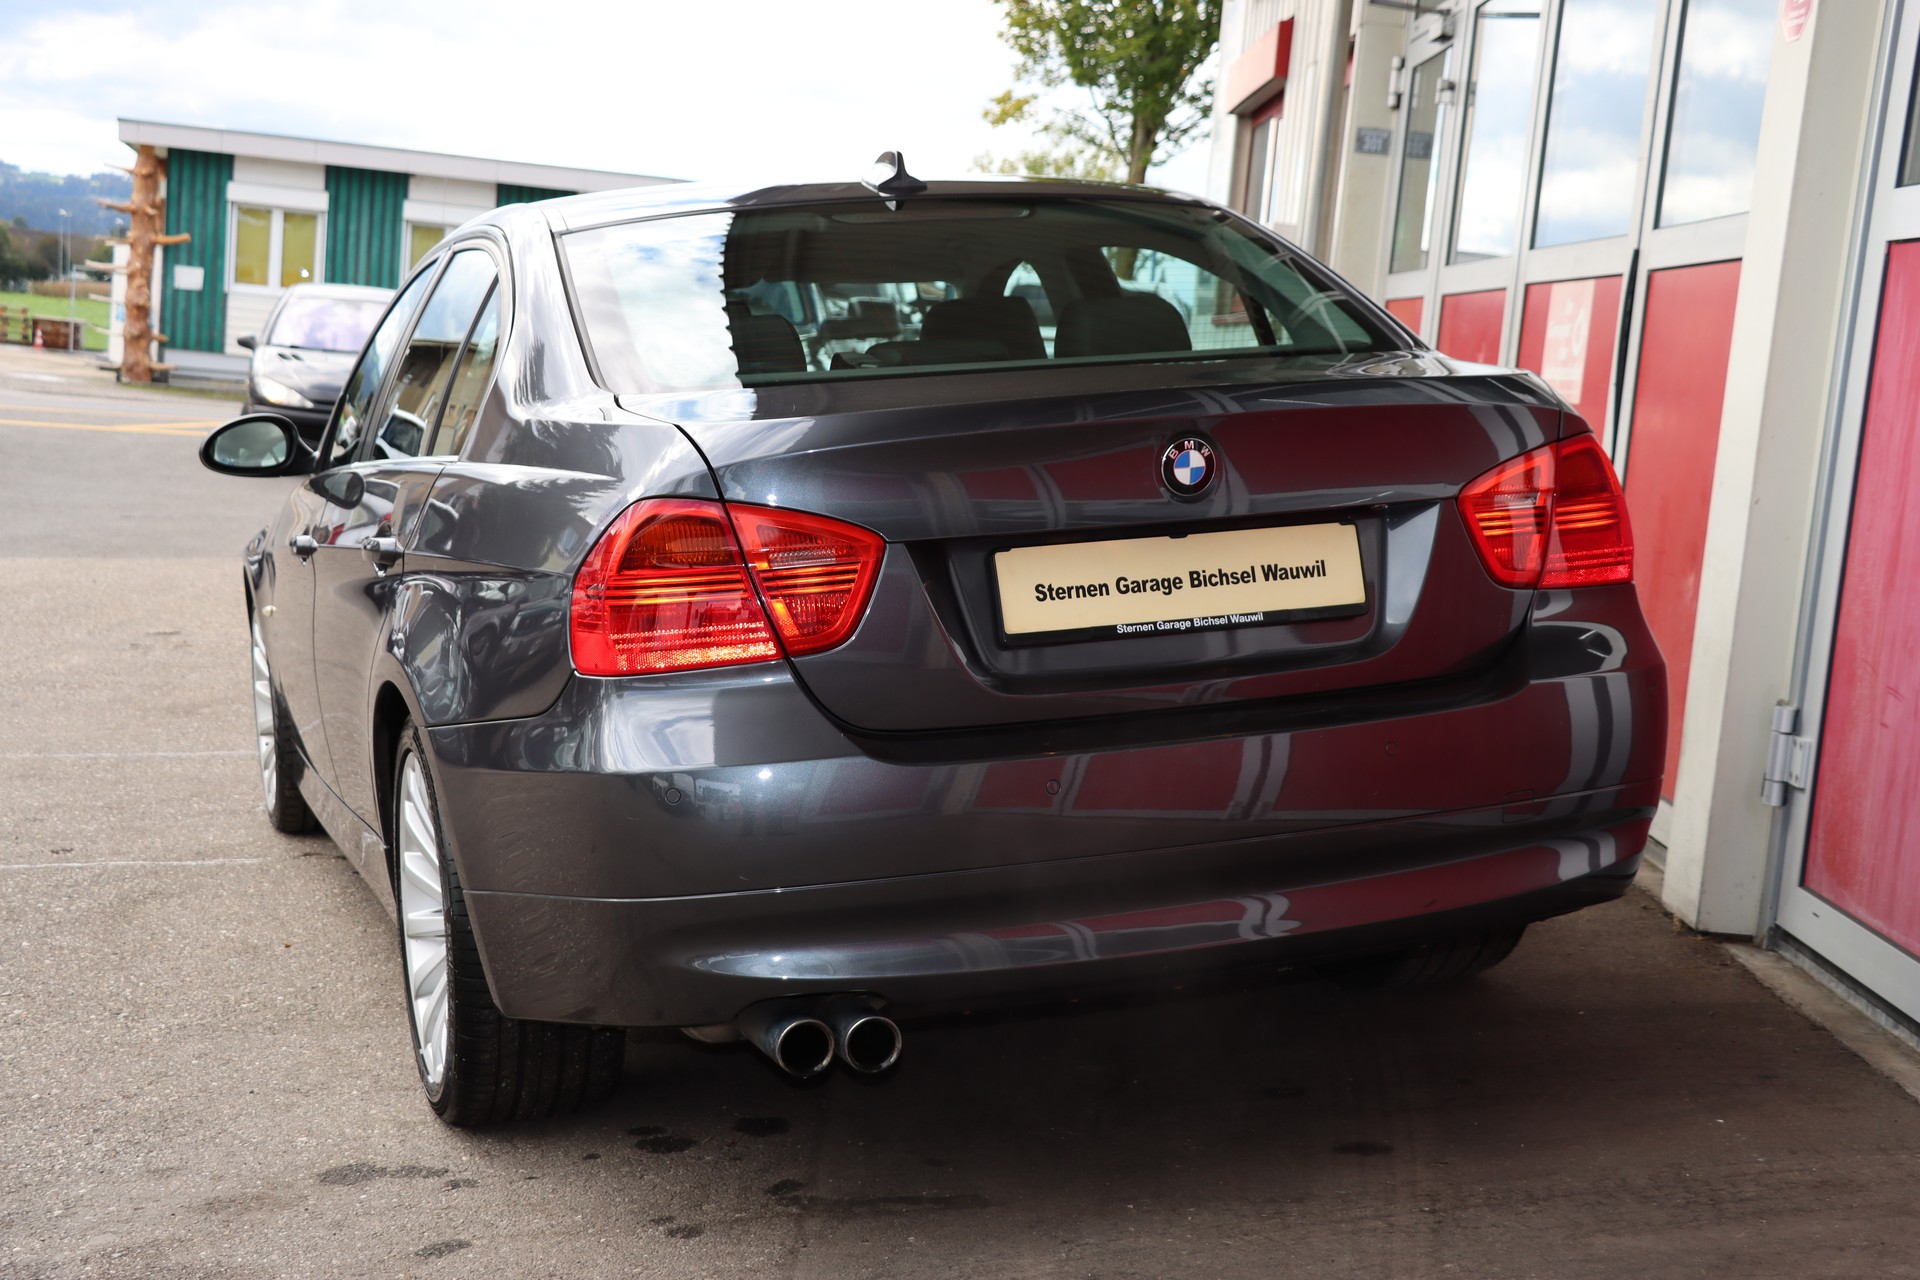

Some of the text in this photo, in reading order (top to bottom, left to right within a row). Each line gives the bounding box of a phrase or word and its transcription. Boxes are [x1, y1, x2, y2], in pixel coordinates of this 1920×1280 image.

[1168, 440, 1211, 460] BMW
[1034, 559, 1327, 602] Sternen Garage Bichsel Wauwil
[1116, 611, 1264, 634] Sternen Garage Bichsel Wauwil
